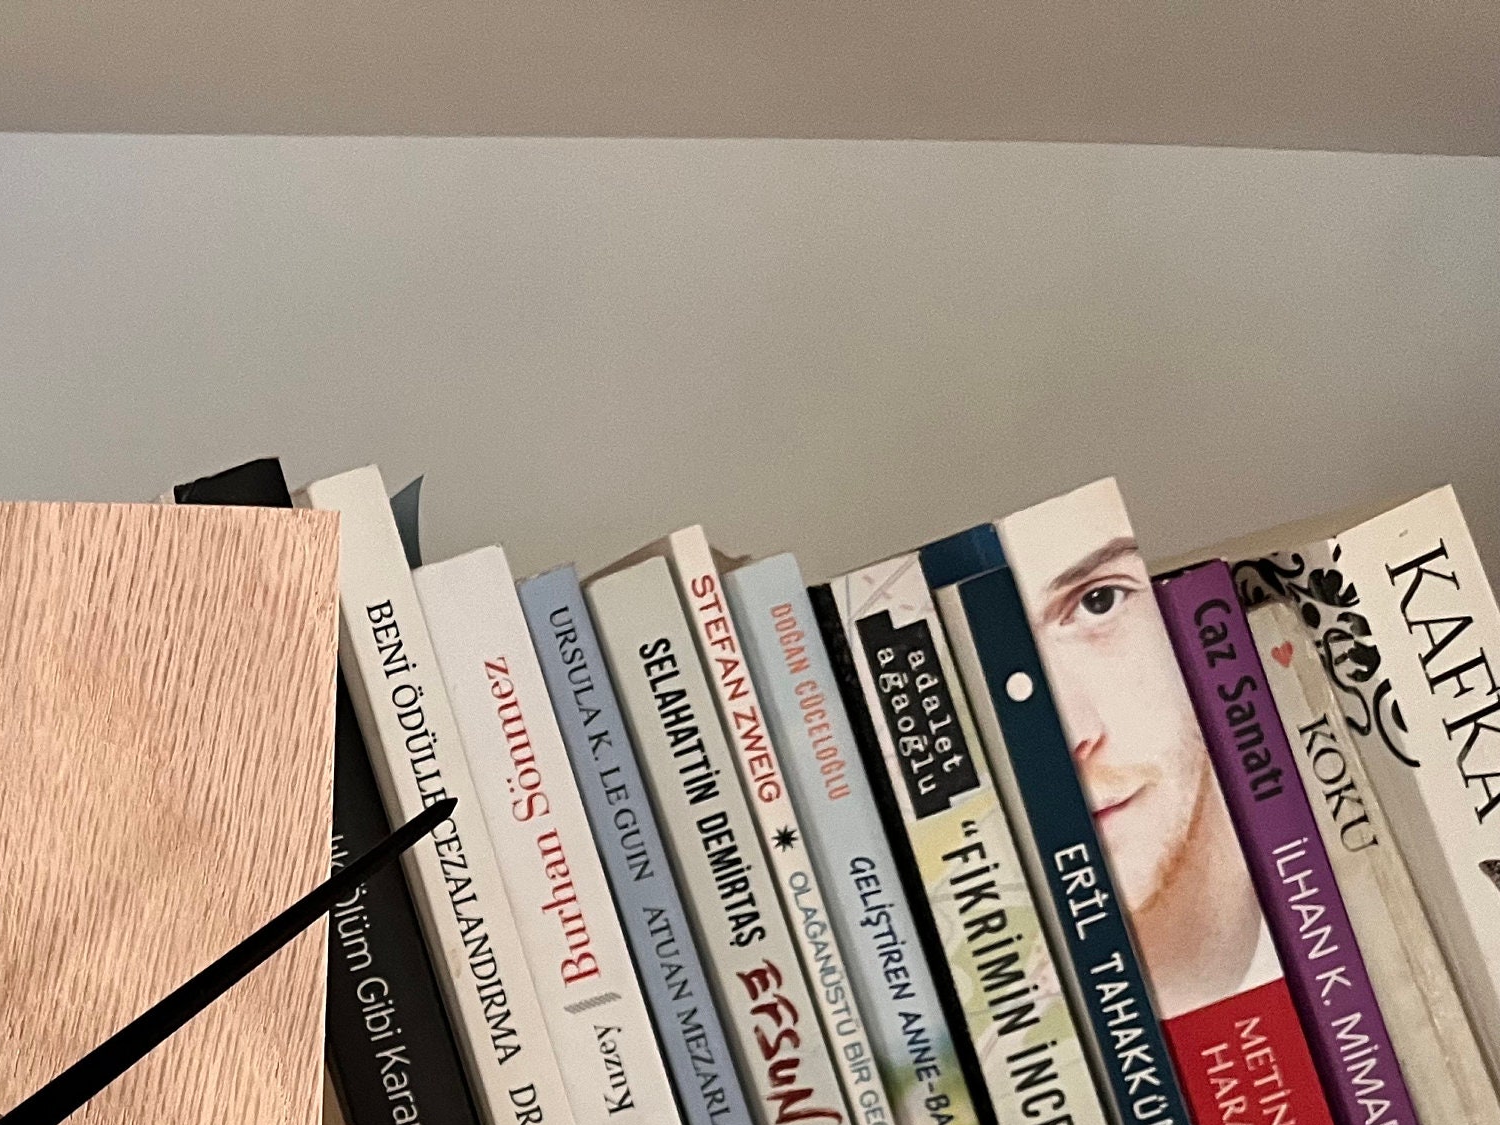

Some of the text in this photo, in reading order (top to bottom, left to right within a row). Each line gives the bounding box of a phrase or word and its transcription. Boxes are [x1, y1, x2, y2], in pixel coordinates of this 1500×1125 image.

[769, 603, 810, 675] DOĞAN
[908, 650, 966, 773] adalet
[1194, 598, 1283, 802] Caz Sanatı
[1385, 538, 1500, 825] KAFKA
[639, 638, 767, 947] SELAHATTİN DEMİRTAŞ
[876, 647, 938, 796] ağaoğlu
[1299, 713, 1378, 852] KOKU
[366, 599, 418, 680] BENİ
[430, 816, 522, 1067] CEZALANDIRMA
[484, 656, 601, 987] Burhan Sönmez
[549, 606, 602, 728] URSULA
[587, 730, 610, 762] K.
[642, 906, 692, 1002] ATUAN
[691, 574, 748, 701] STEFAN
[732, 705, 781, 804] ZWEIG
[789, 870, 858, 1037] OLAĞANÜSTÜ
[844, 1038, 872, 1088] BİR
[848, 856, 915, 1003] GELİŞTİREN
[1054, 842, 1110, 941] ERİL
[1272, 838, 1340, 959] İLHAN
[1316, 970, 1352, 1007] K.
[355, 976, 401, 1041] Gibi
[593, 1023, 634, 1116] Kuzey
